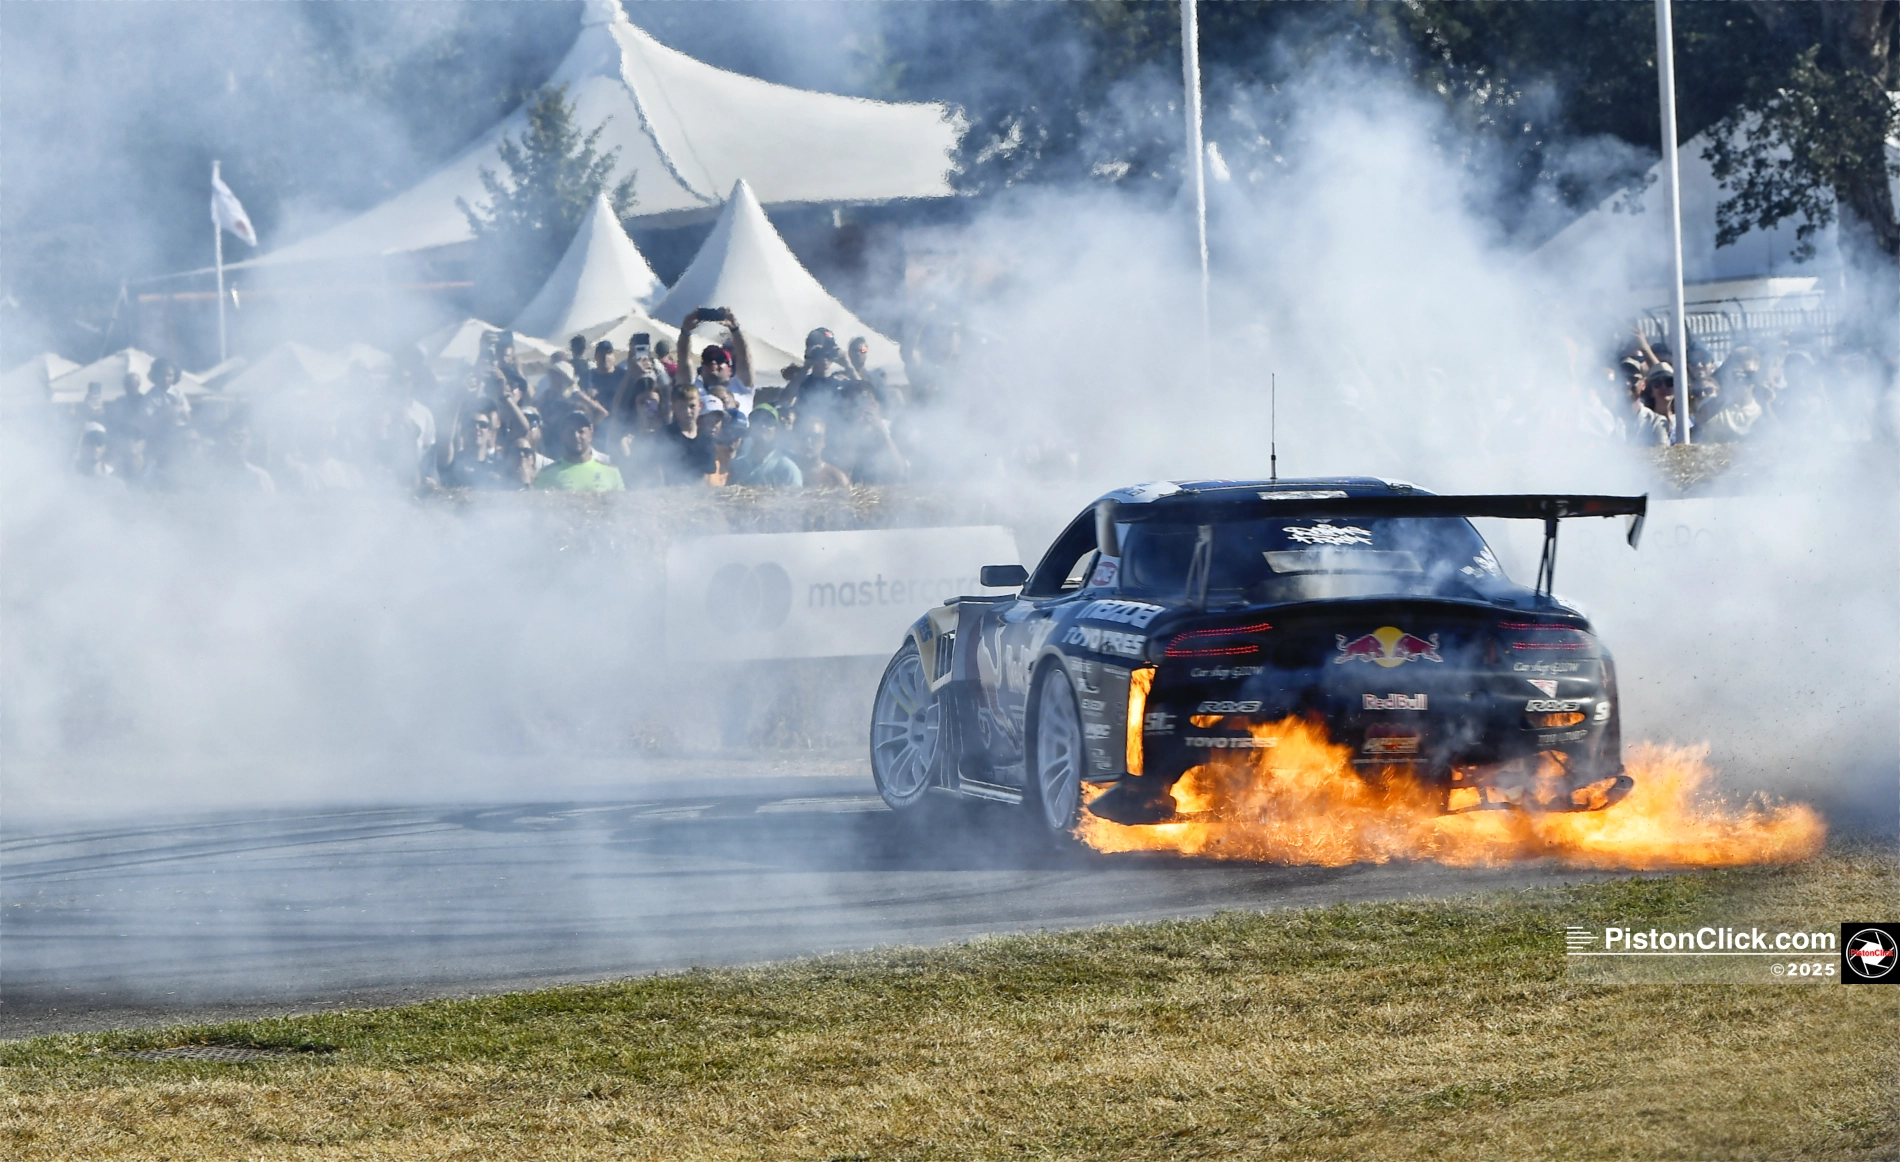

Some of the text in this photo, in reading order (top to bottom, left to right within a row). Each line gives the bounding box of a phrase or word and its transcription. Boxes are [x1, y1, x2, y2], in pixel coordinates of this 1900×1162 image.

[1197, 700, 1263, 713] RAYS
[1362, 693, 1395, 710] Red
[1525, 699, 1580, 712] RAYS
[1184, 737, 1228, 748] TOYO
